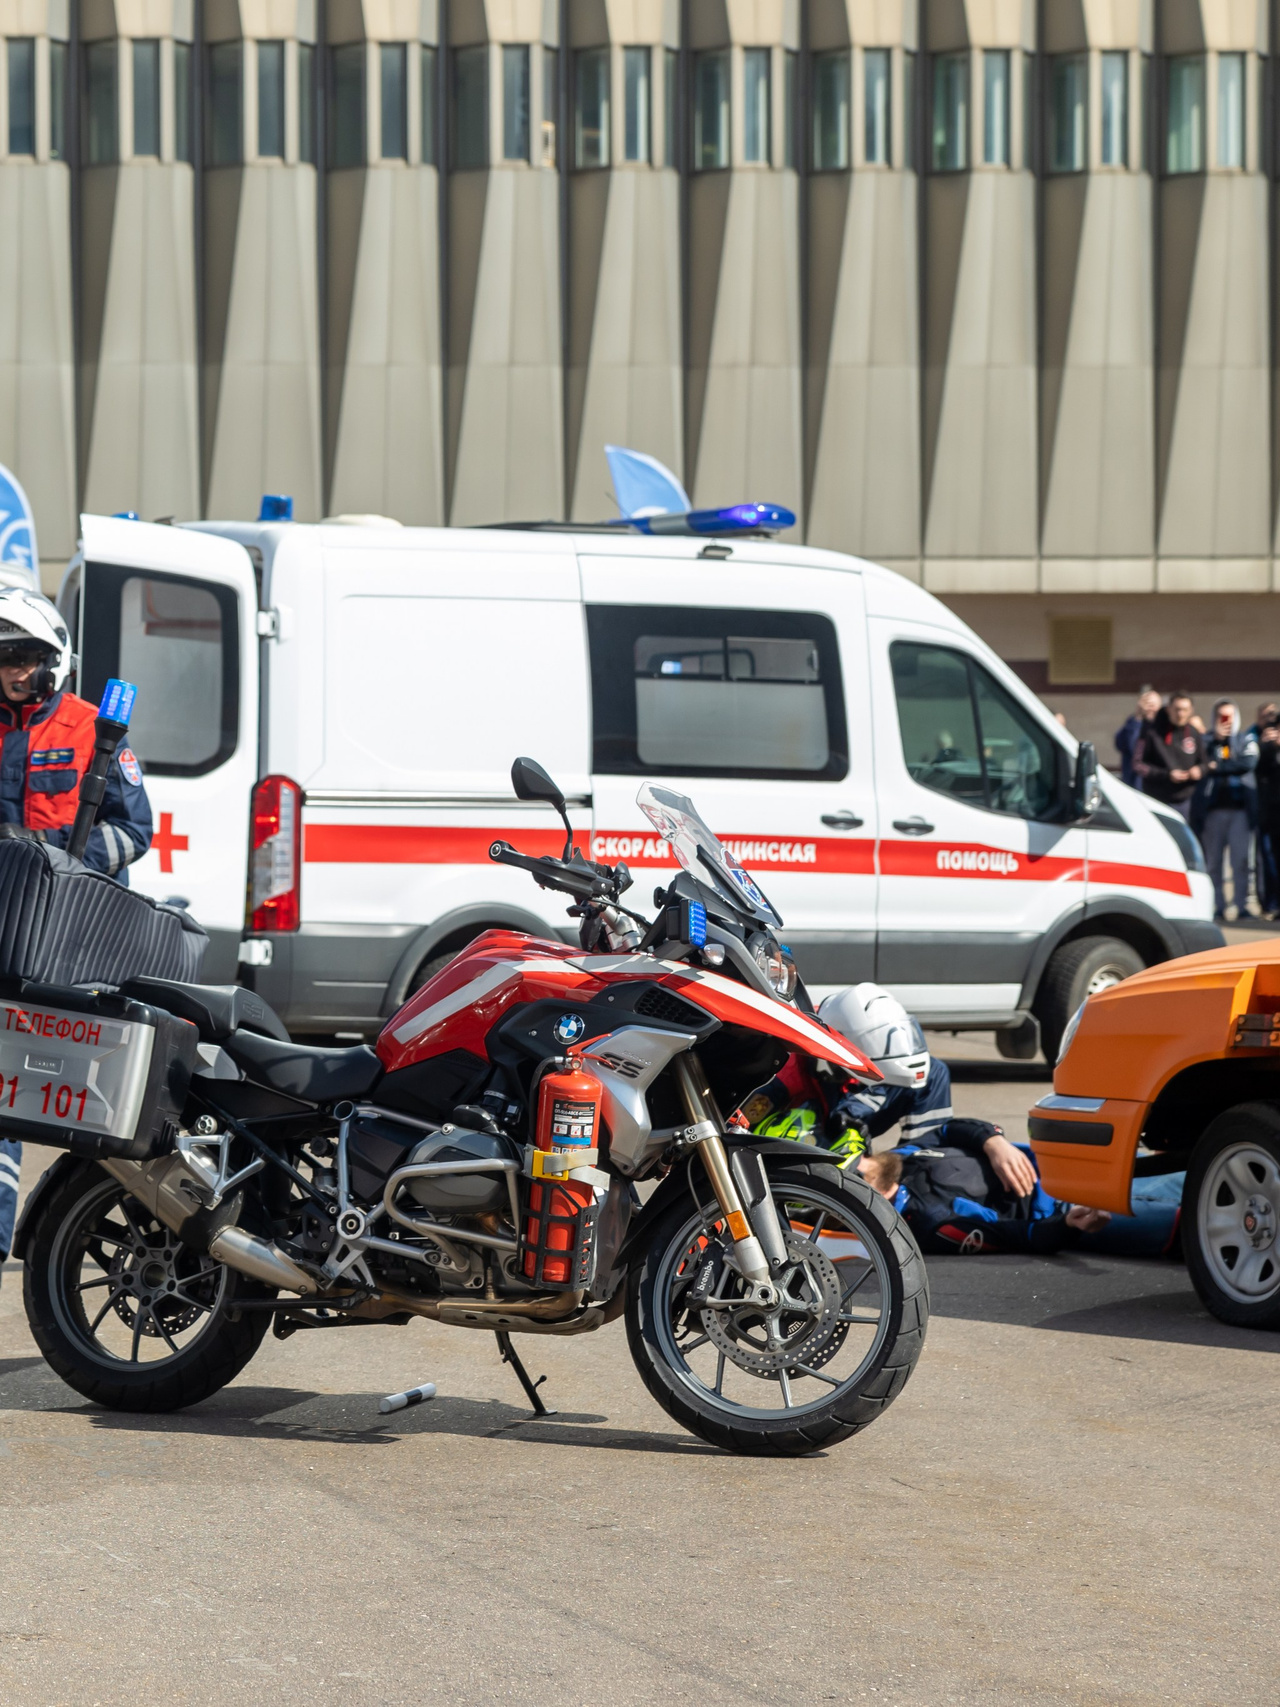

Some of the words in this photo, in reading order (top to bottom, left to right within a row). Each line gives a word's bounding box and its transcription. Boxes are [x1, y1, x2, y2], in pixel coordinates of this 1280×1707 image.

[592, 837, 669, 858] СКОРАЯ
[721, 840, 816, 863] ЦИНСКАЯ
[936, 850, 1019, 875] ПОМОЩЬ
[5, 1007, 102, 1047] ТЕЛЕФОН
[40, 1081, 88, 1122] 101
[696, 1260, 715, 1292] brembo
